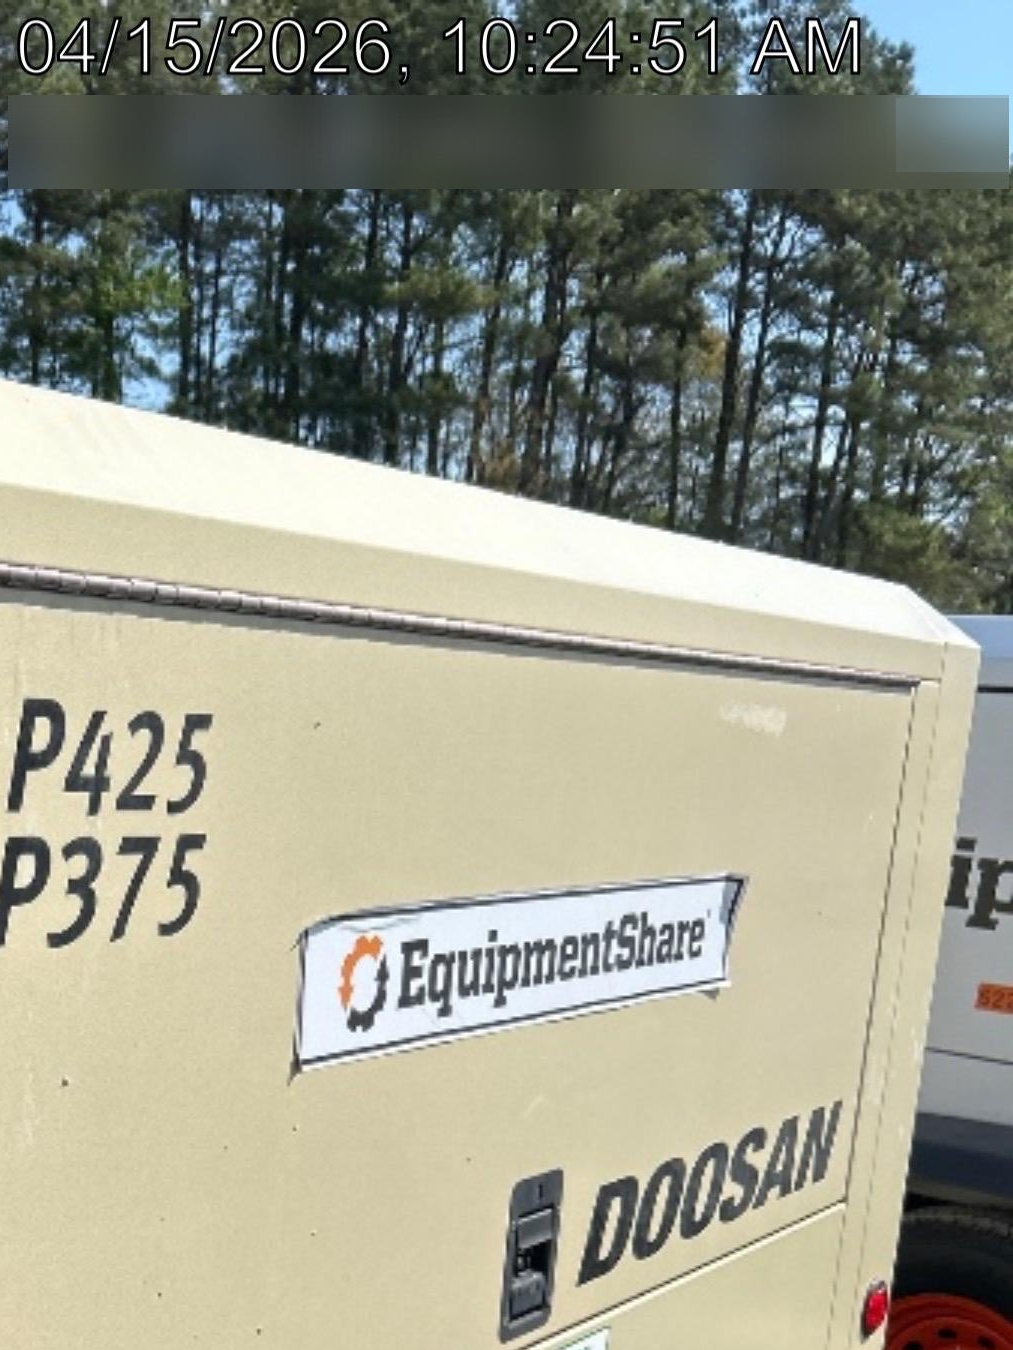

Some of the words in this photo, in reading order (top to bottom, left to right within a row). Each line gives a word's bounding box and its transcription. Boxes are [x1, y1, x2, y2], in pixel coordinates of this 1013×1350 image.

[7, 697, 214, 816] P425
[397, 911, 706, 1017] EquipmentShare
[576, 1099, 843, 1287] DOOSAN
